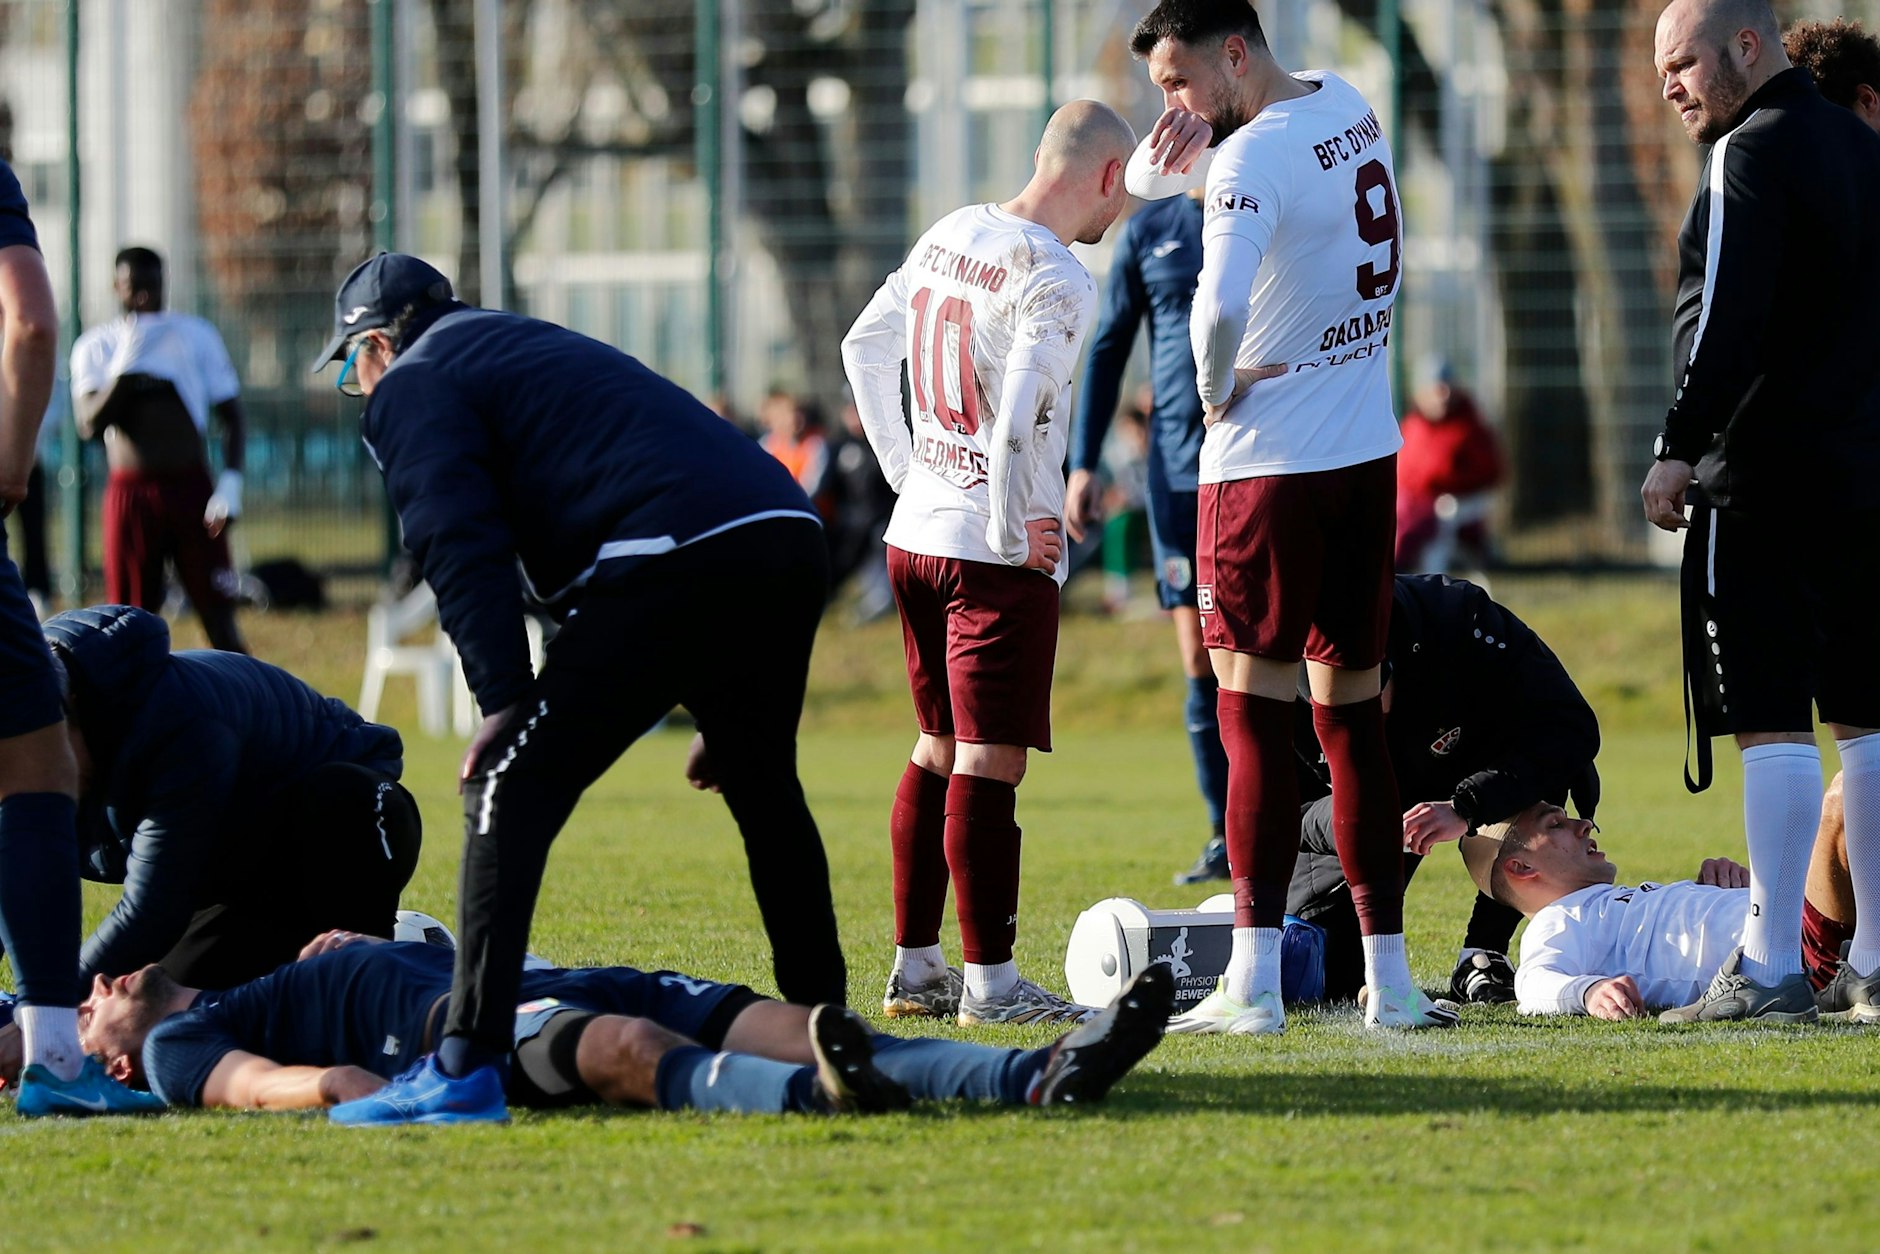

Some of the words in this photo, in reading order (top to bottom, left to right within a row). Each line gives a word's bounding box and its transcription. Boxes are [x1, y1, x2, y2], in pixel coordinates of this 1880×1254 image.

[1313, 136, 1349, 171] BFC
[941, 251, 1008, 293] DYNAMO
[1355, 158, 1401, 300] 9
[911, 286, 980, 437] 10
